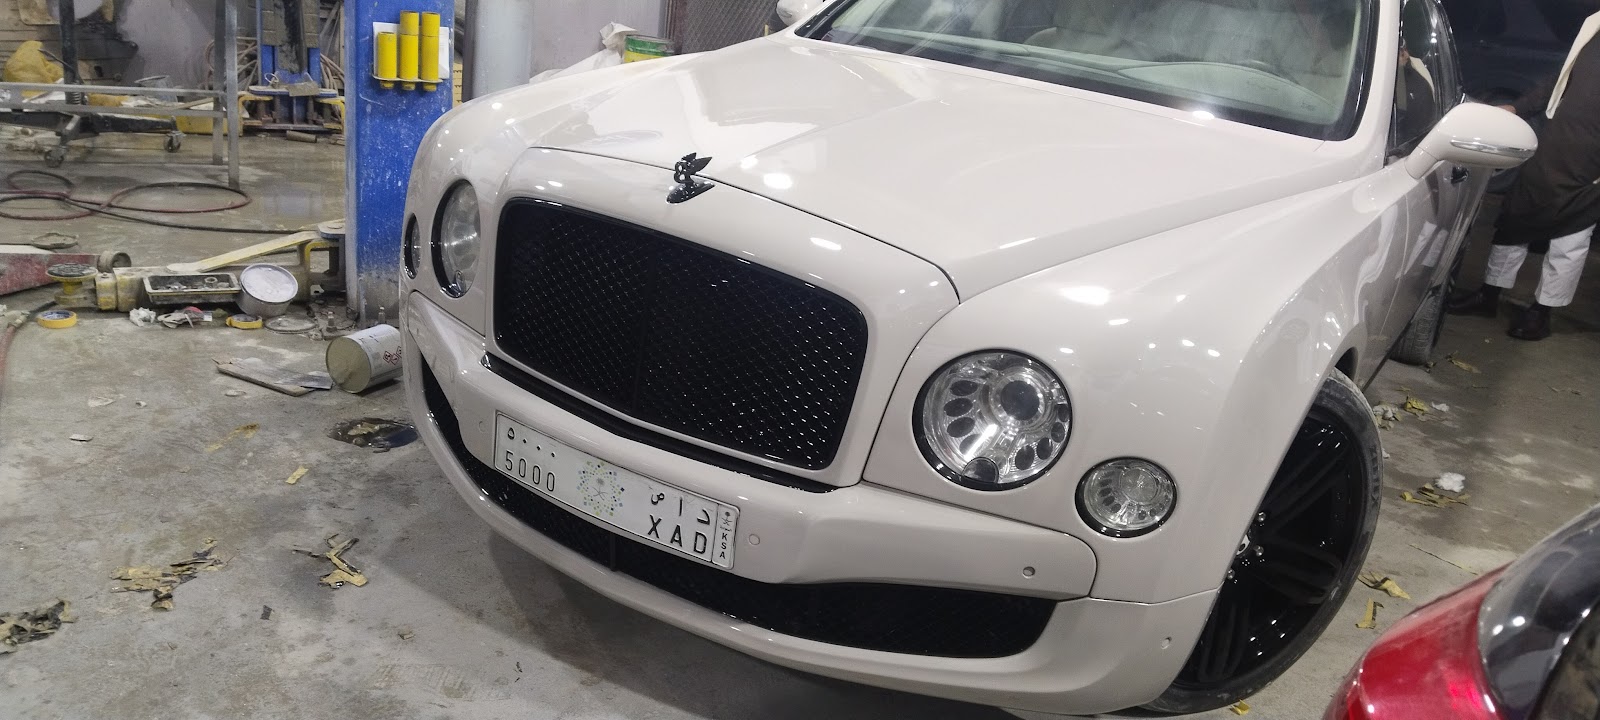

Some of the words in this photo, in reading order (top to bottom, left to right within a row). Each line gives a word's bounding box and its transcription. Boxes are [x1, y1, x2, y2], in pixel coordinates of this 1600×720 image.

[505, 450, 555, 492] 5000
[647, 514, 708, 555] XAD
[719, 532, 729, 560] KSA
